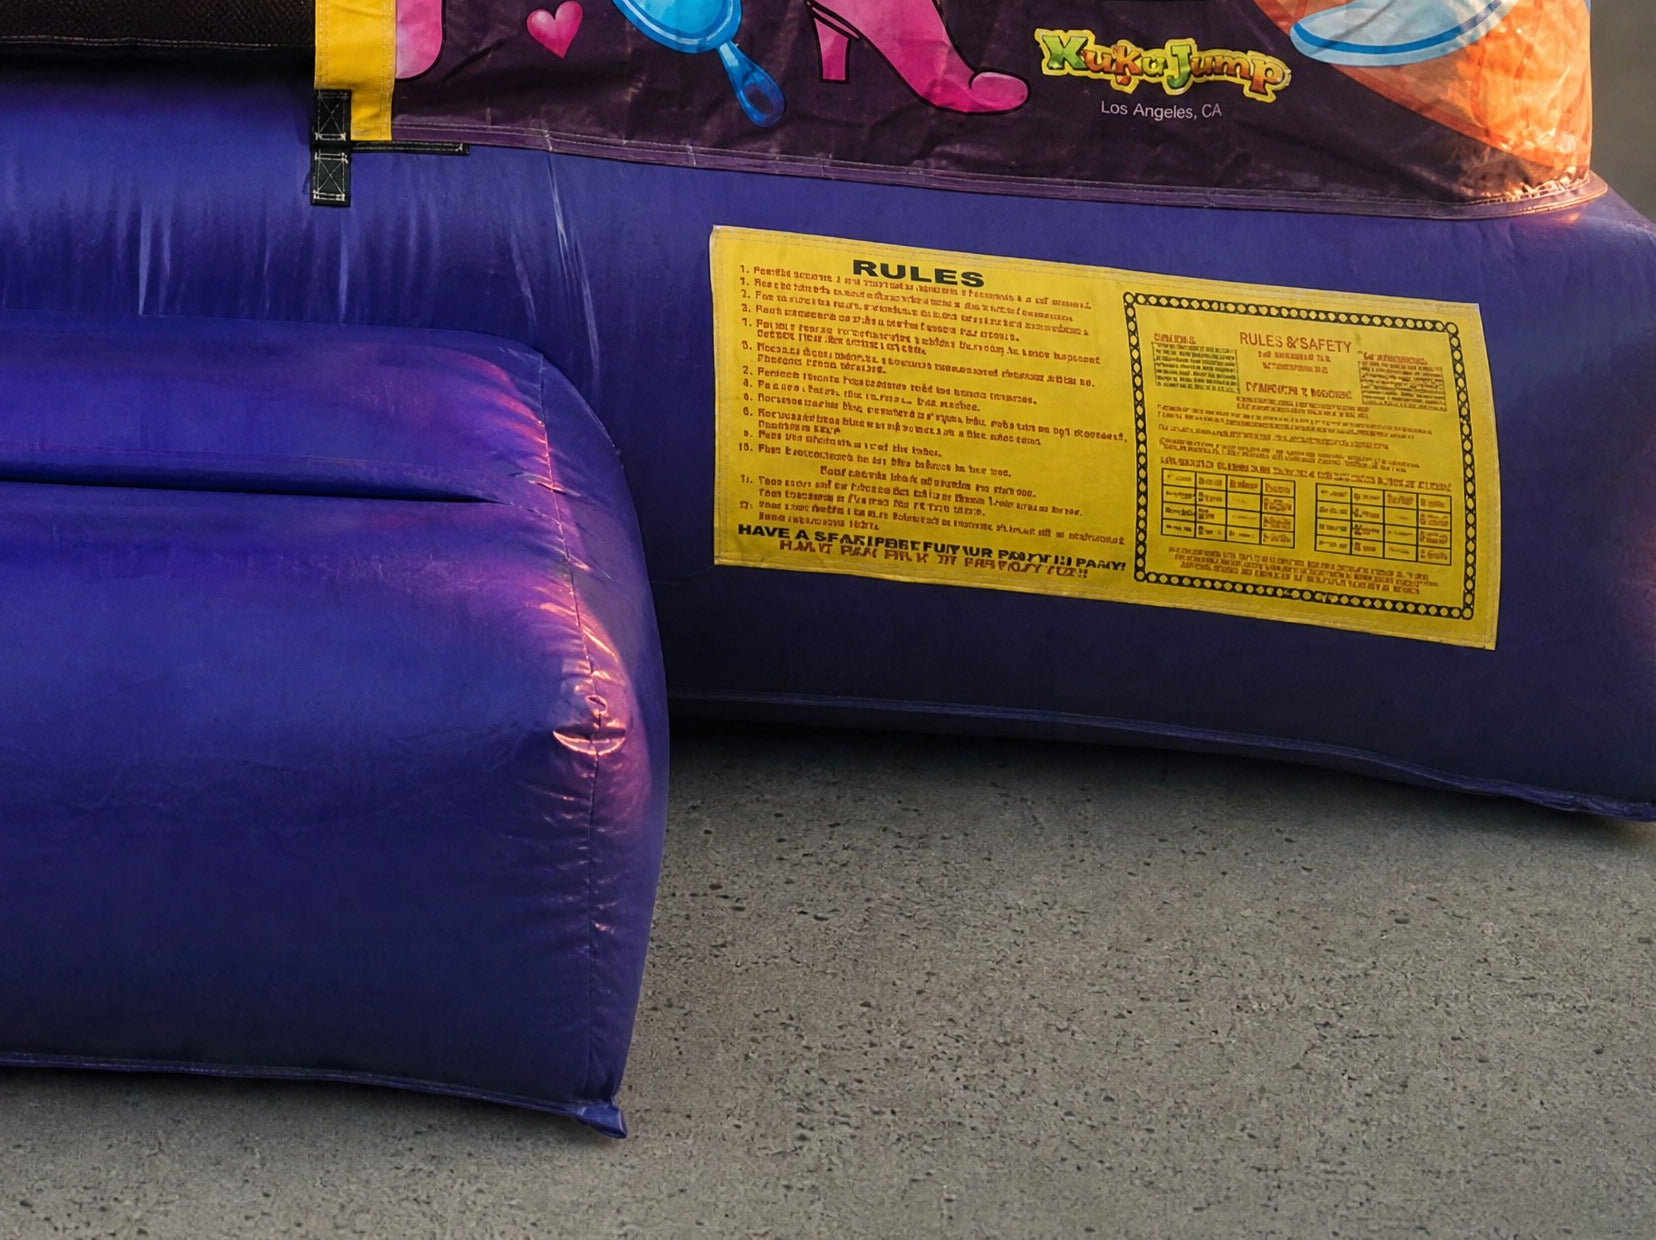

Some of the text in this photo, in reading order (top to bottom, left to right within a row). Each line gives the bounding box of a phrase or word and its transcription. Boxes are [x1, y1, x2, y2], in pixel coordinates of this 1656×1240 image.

[1100, 100, 1222, 121] Los Angeles, CA
[852, 259, 985, 288] RULES
[1239, 331, 1283, 349] RULES
[1299, 336, 1352, 353] SAFETY
[737, 523, 790, 539] HAVE
[794, 529, 810, 541] A
